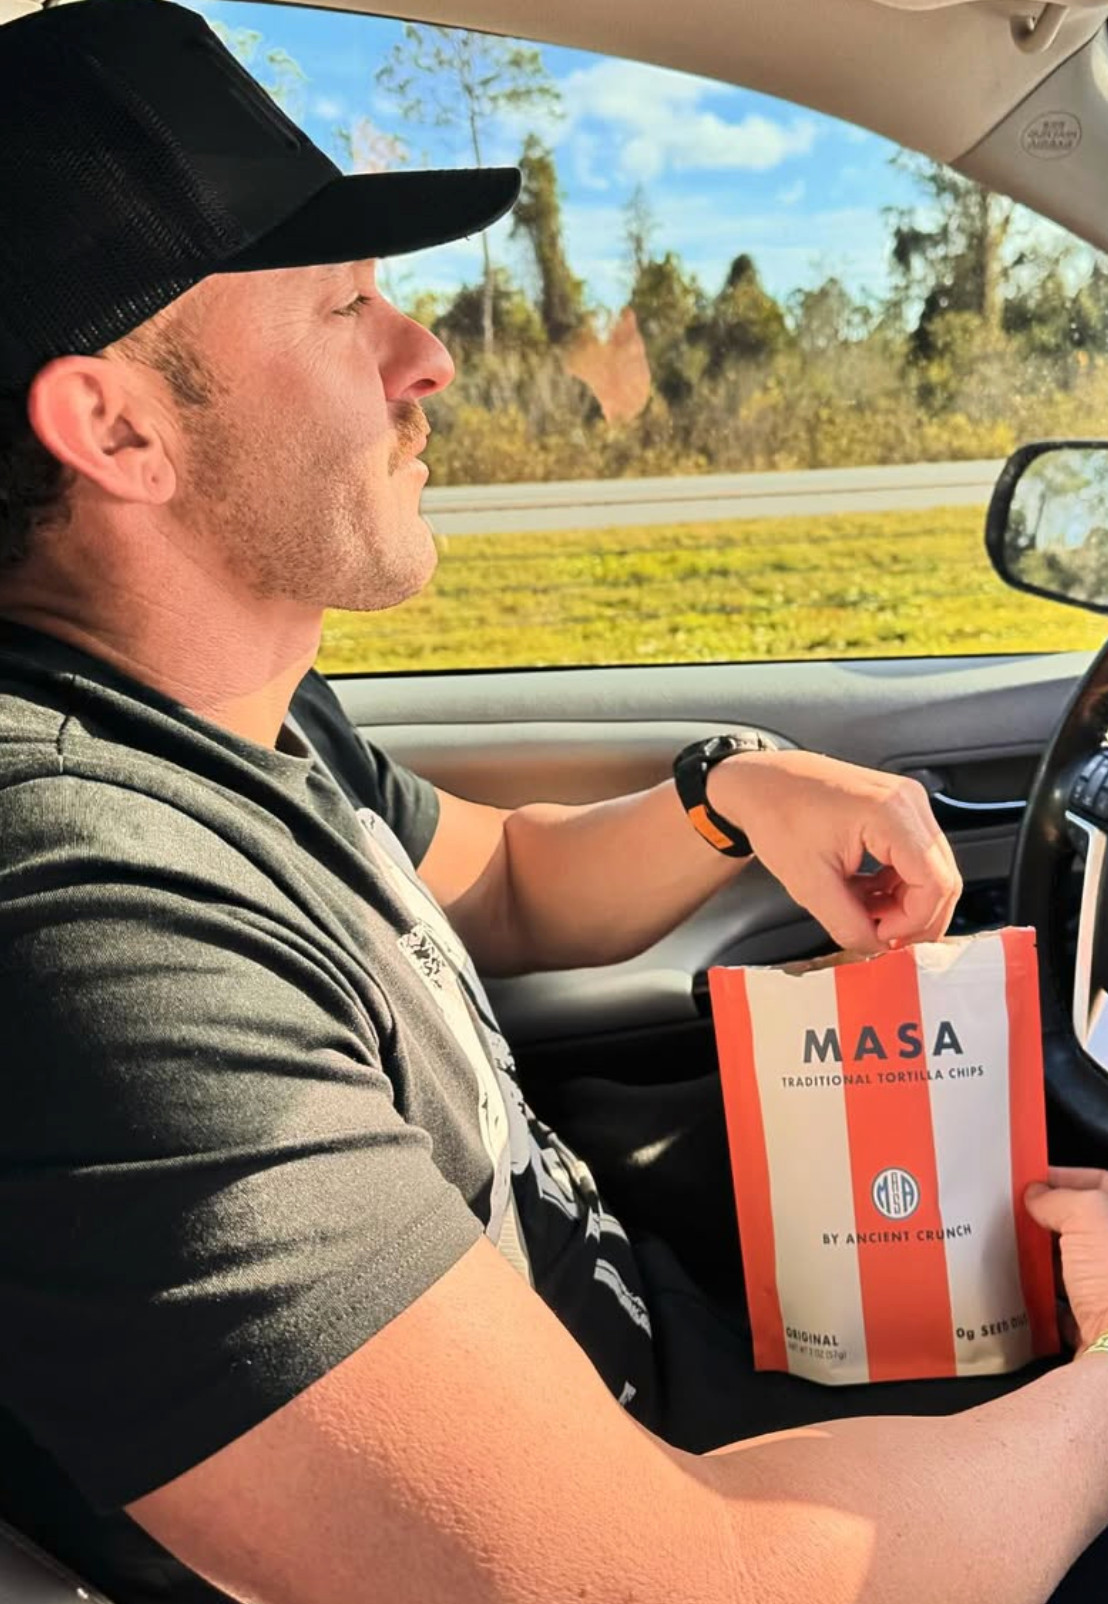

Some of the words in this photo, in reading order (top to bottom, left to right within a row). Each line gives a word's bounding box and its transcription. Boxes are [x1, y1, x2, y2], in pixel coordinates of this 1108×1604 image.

[803, 1021, 964, 1063] MASA
[782, 1073, 871, 1088] TRADITIONAL
[877, 1067, 944, 1083] TORTILLA
[949, 1065, 984, 1079] CHIPS
[823, 1233, 839, 1244] BY
[846, 1231, 910, 1244] ANCIENT
[916, 1223, 972, 1240] CRUNCH
[786, 1326, 839, 1346] ORIGINAL
[981, 1319, 1009, 1337] SEED
